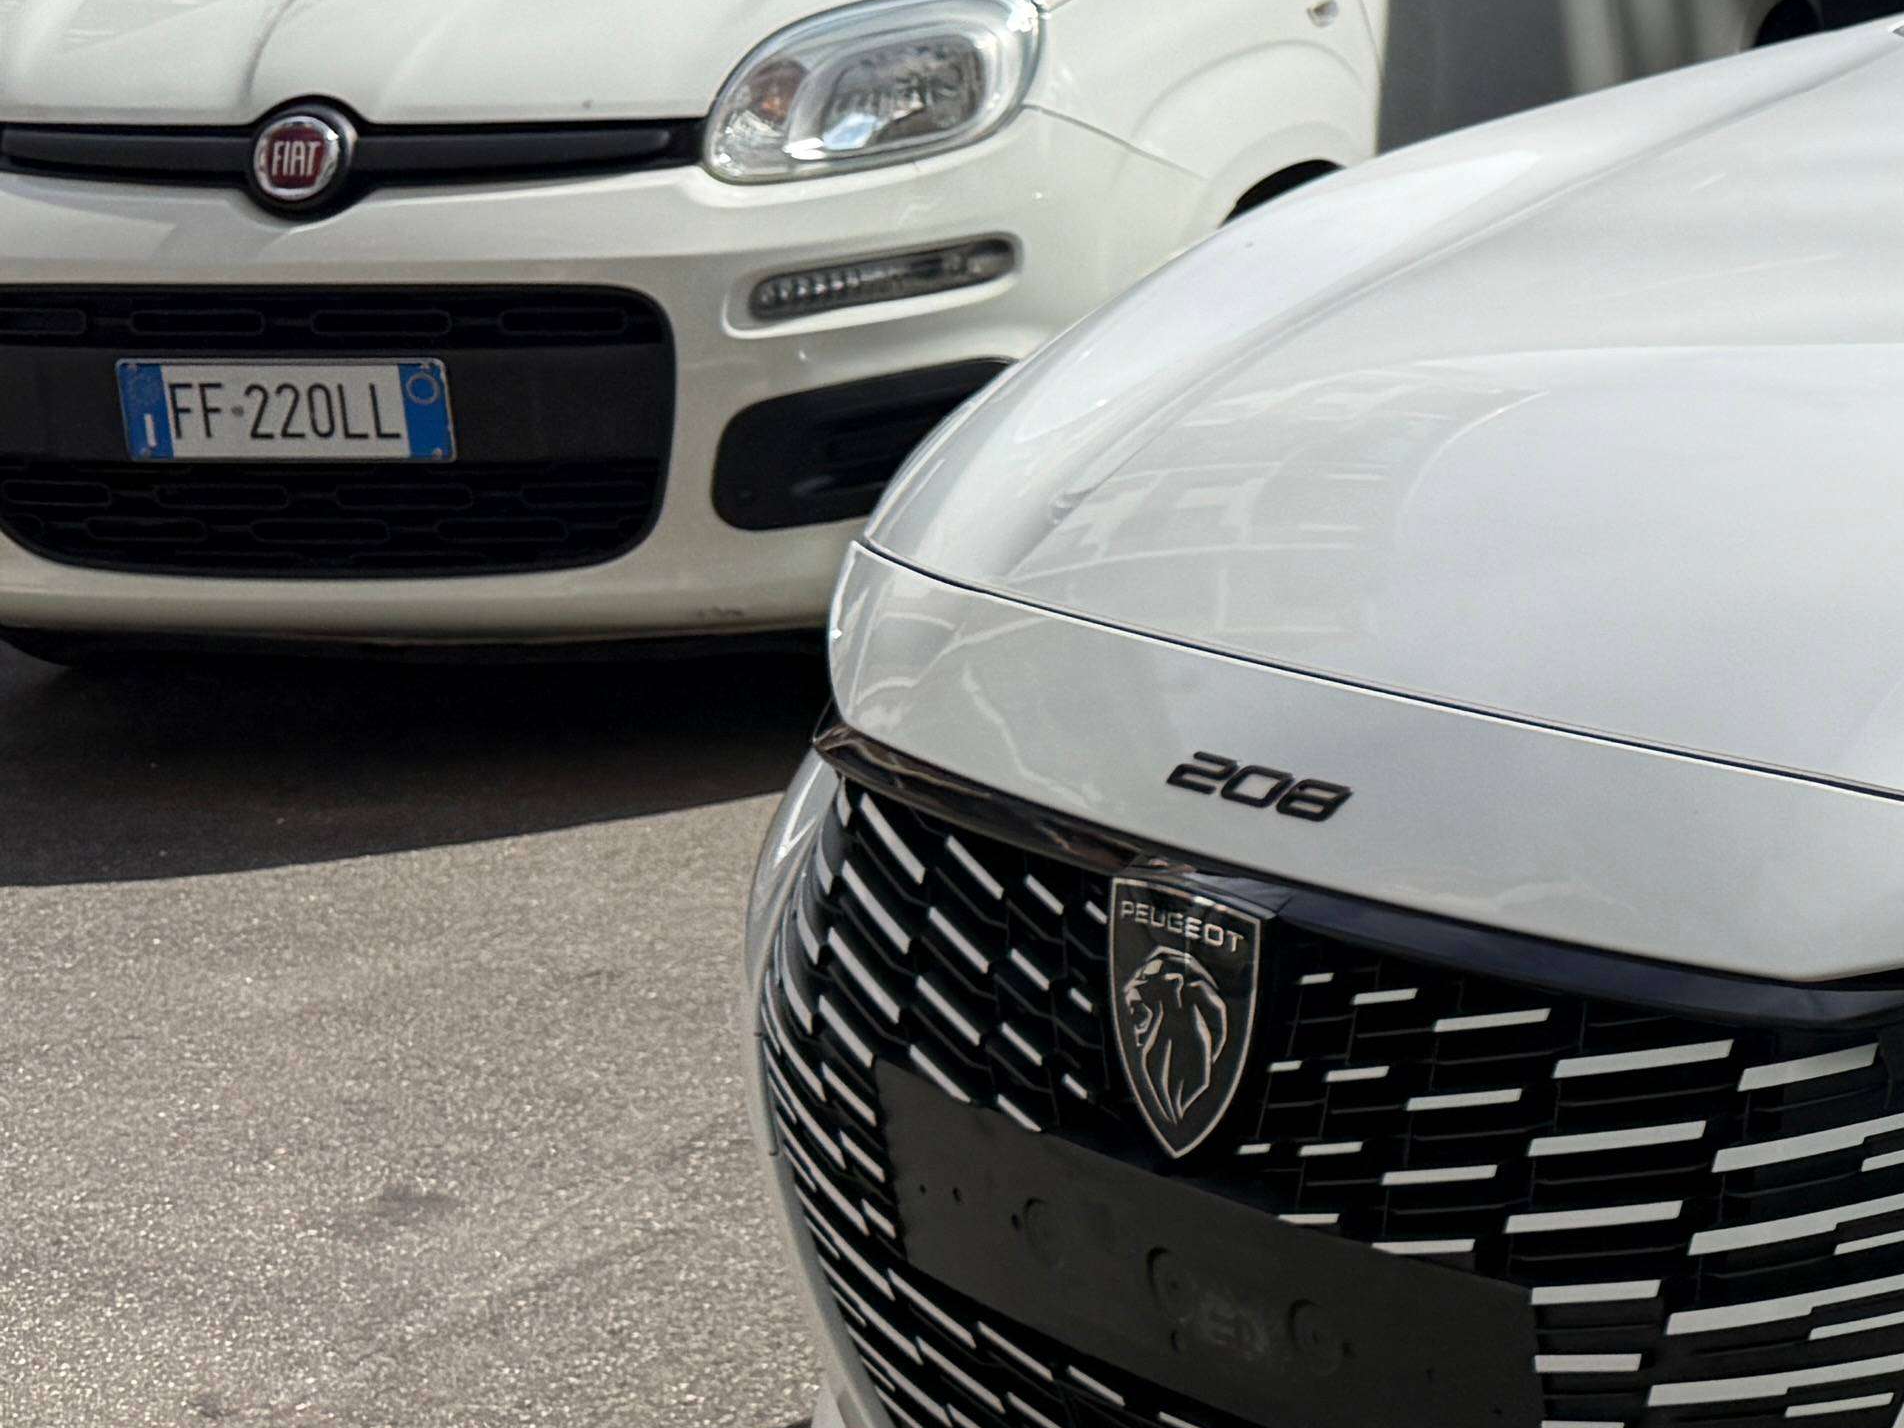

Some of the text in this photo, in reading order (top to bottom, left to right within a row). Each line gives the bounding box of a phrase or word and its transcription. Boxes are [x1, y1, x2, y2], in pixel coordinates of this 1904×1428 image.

[271, 140, 321, 178] FIAT
[1166, 751, 1354, 822] 208
[1120, 899, 1245, 953] PEUGEOT
